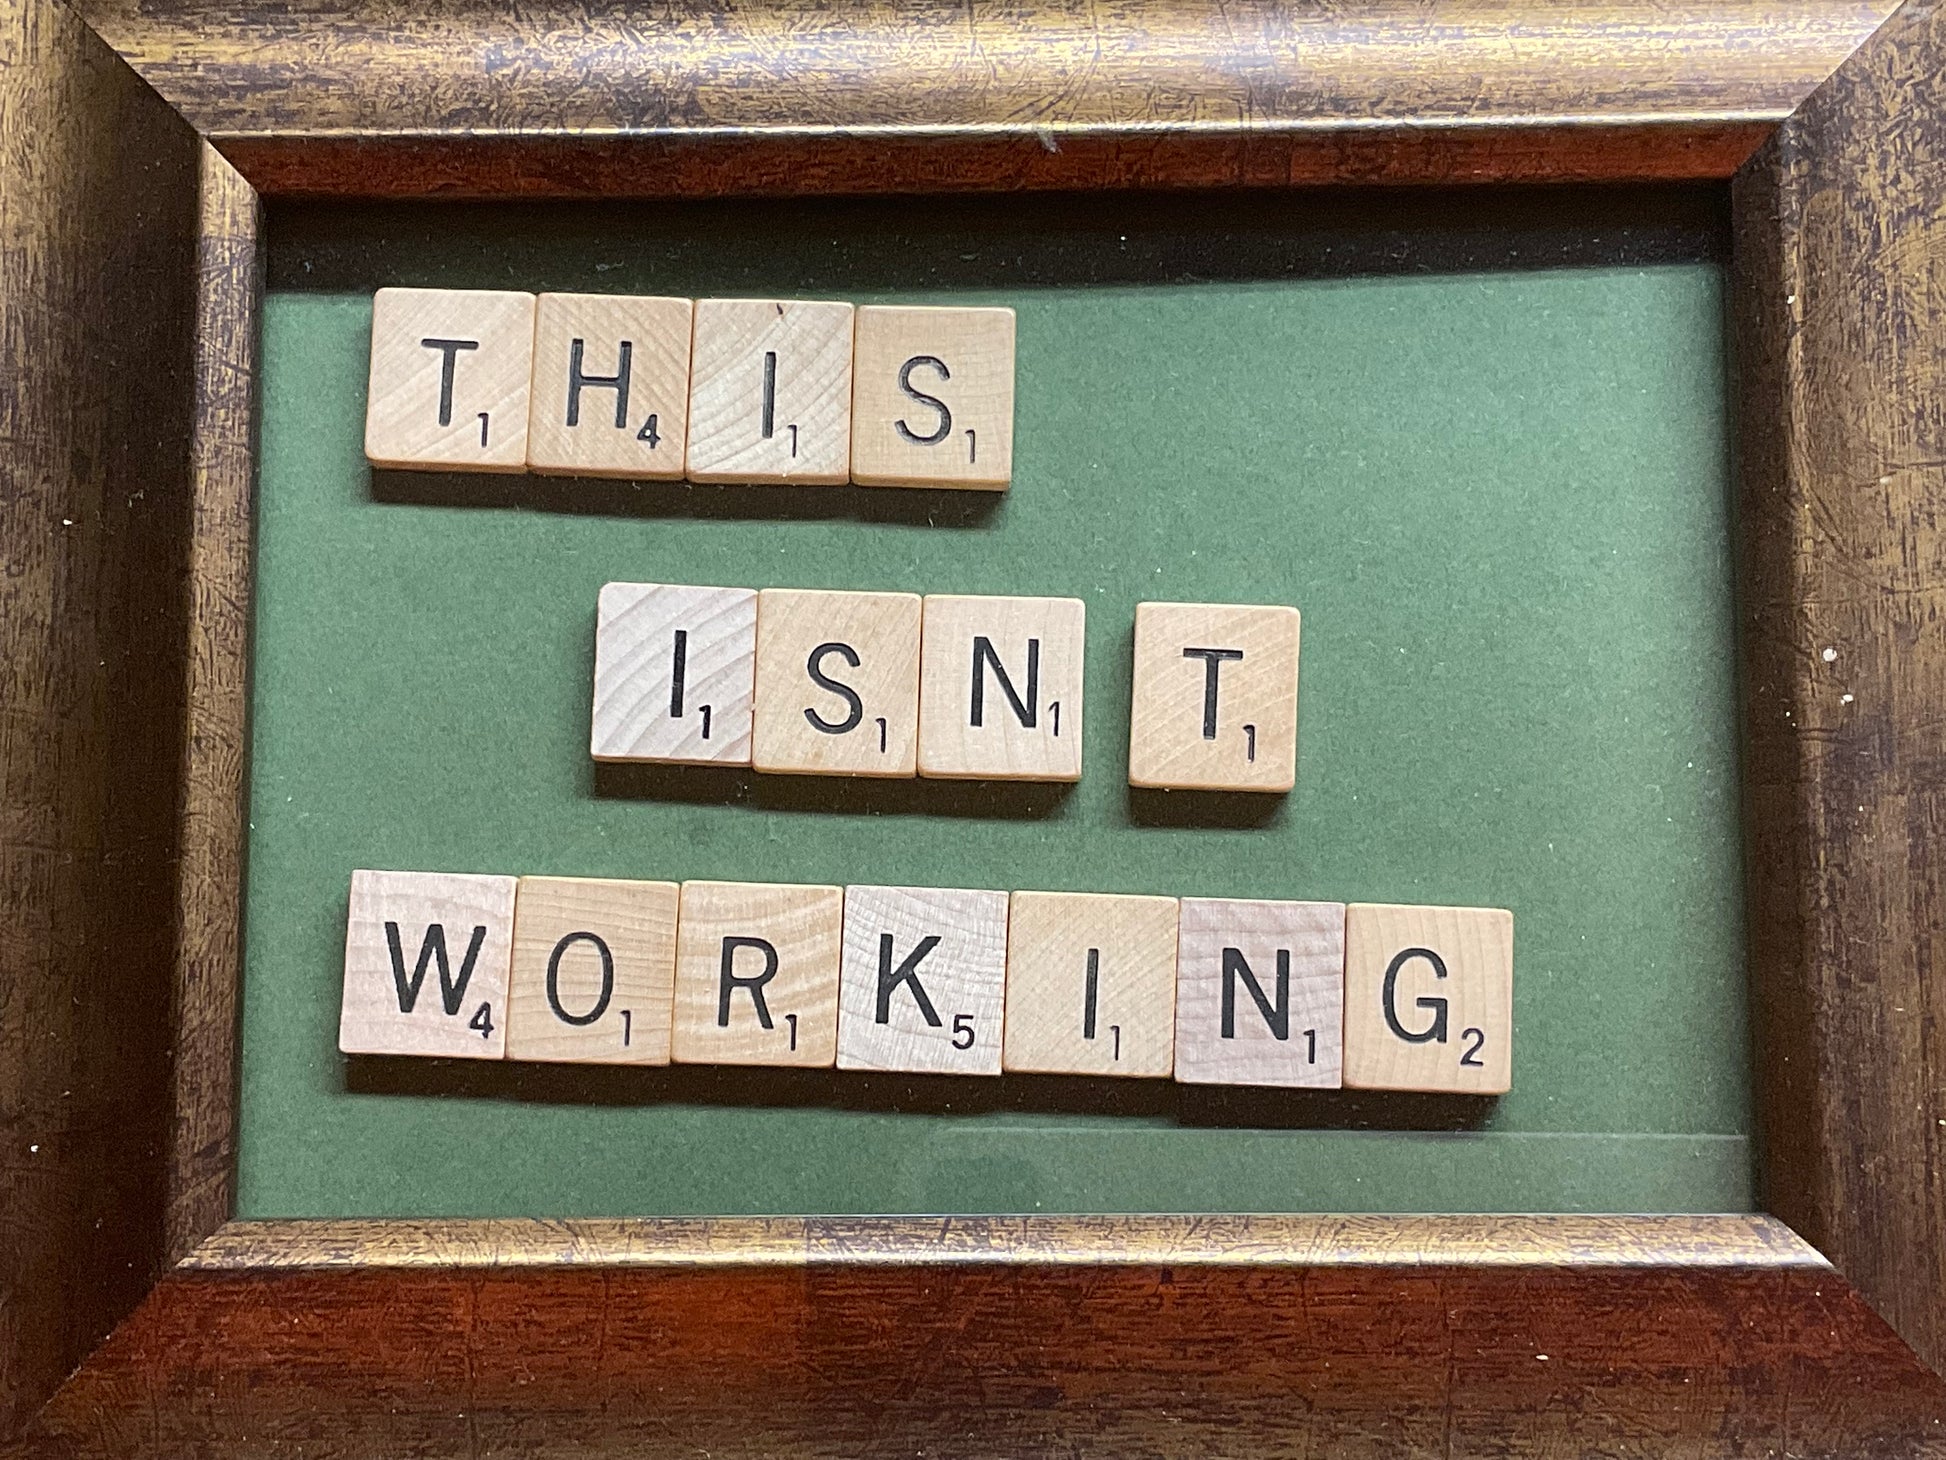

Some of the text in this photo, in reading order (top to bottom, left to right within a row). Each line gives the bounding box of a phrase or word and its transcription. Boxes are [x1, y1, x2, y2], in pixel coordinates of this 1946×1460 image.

[422, 338, 953, 446] THIS
[478, 412, 977, 463] 1 4 1 1
[698, 702, 1256, 763] 1 1 1 1
[384, 921, 1448, 1044] WORKING
[469, 1001, 1485, 1067] 4 1 1 5 1 1 2
